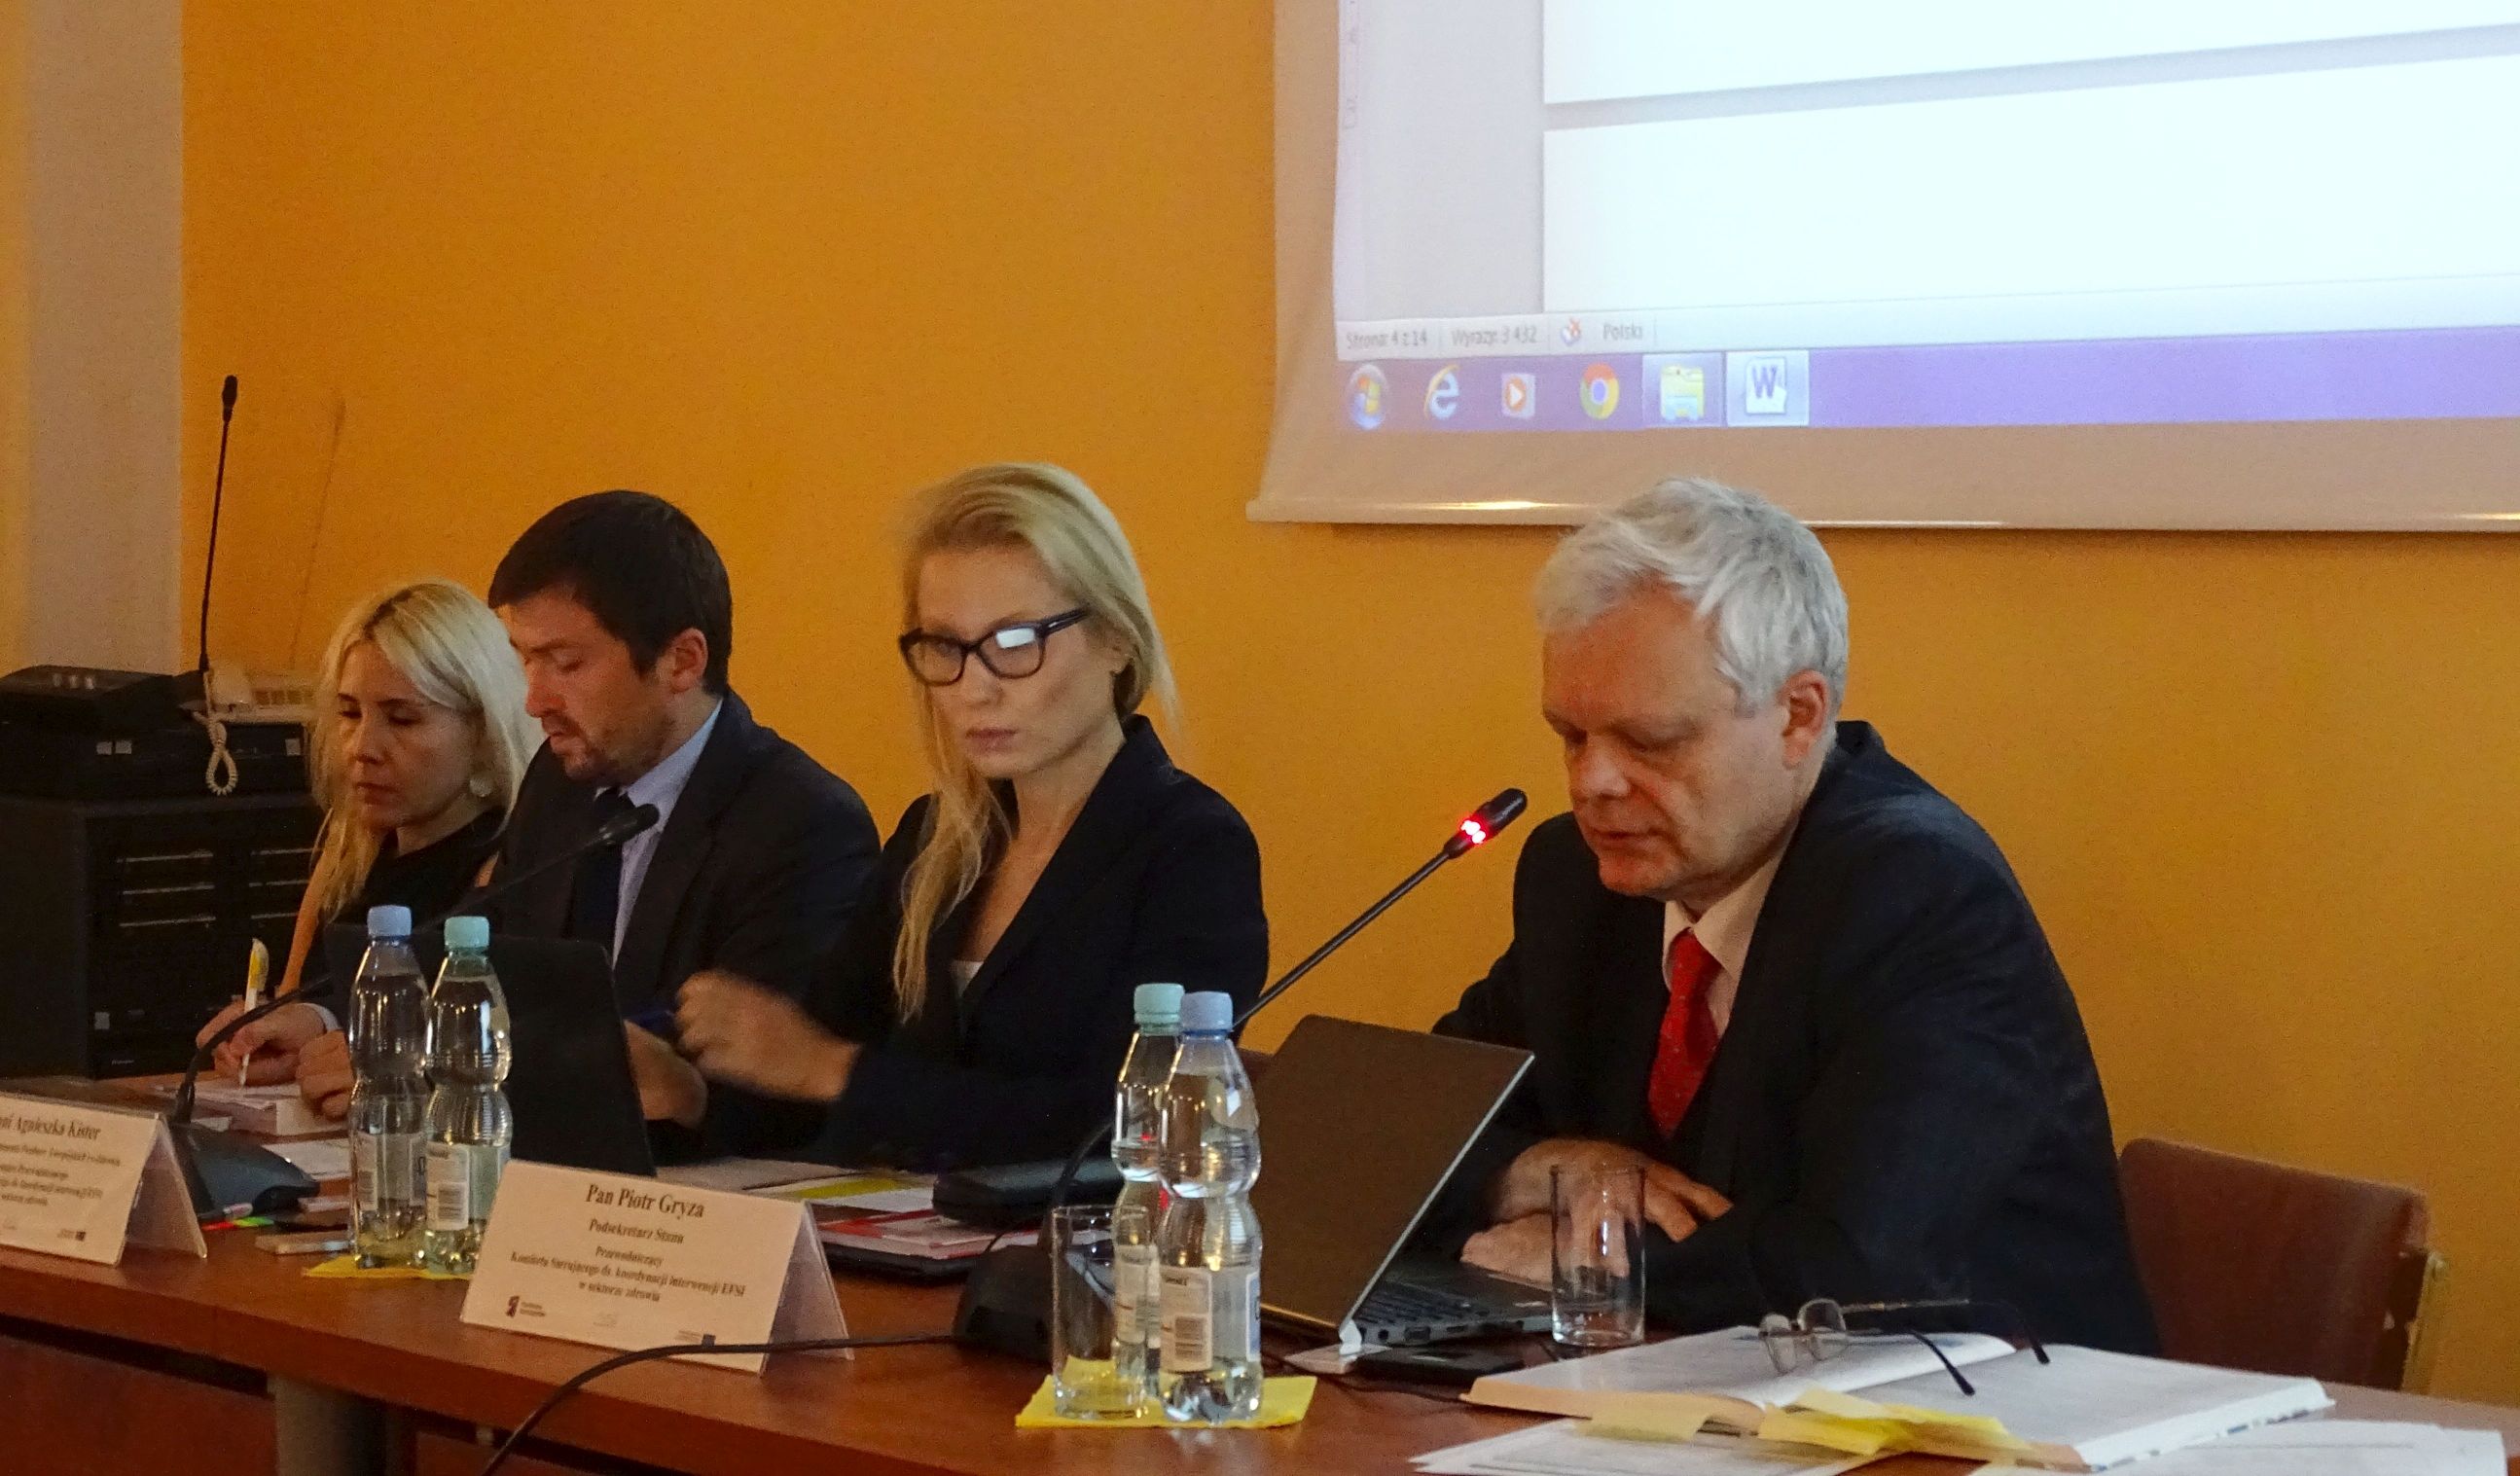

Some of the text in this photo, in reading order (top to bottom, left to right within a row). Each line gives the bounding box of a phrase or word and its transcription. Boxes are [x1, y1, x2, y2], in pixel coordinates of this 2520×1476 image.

[586, 1183, 705, 1221] Pan Piotr Gryza
